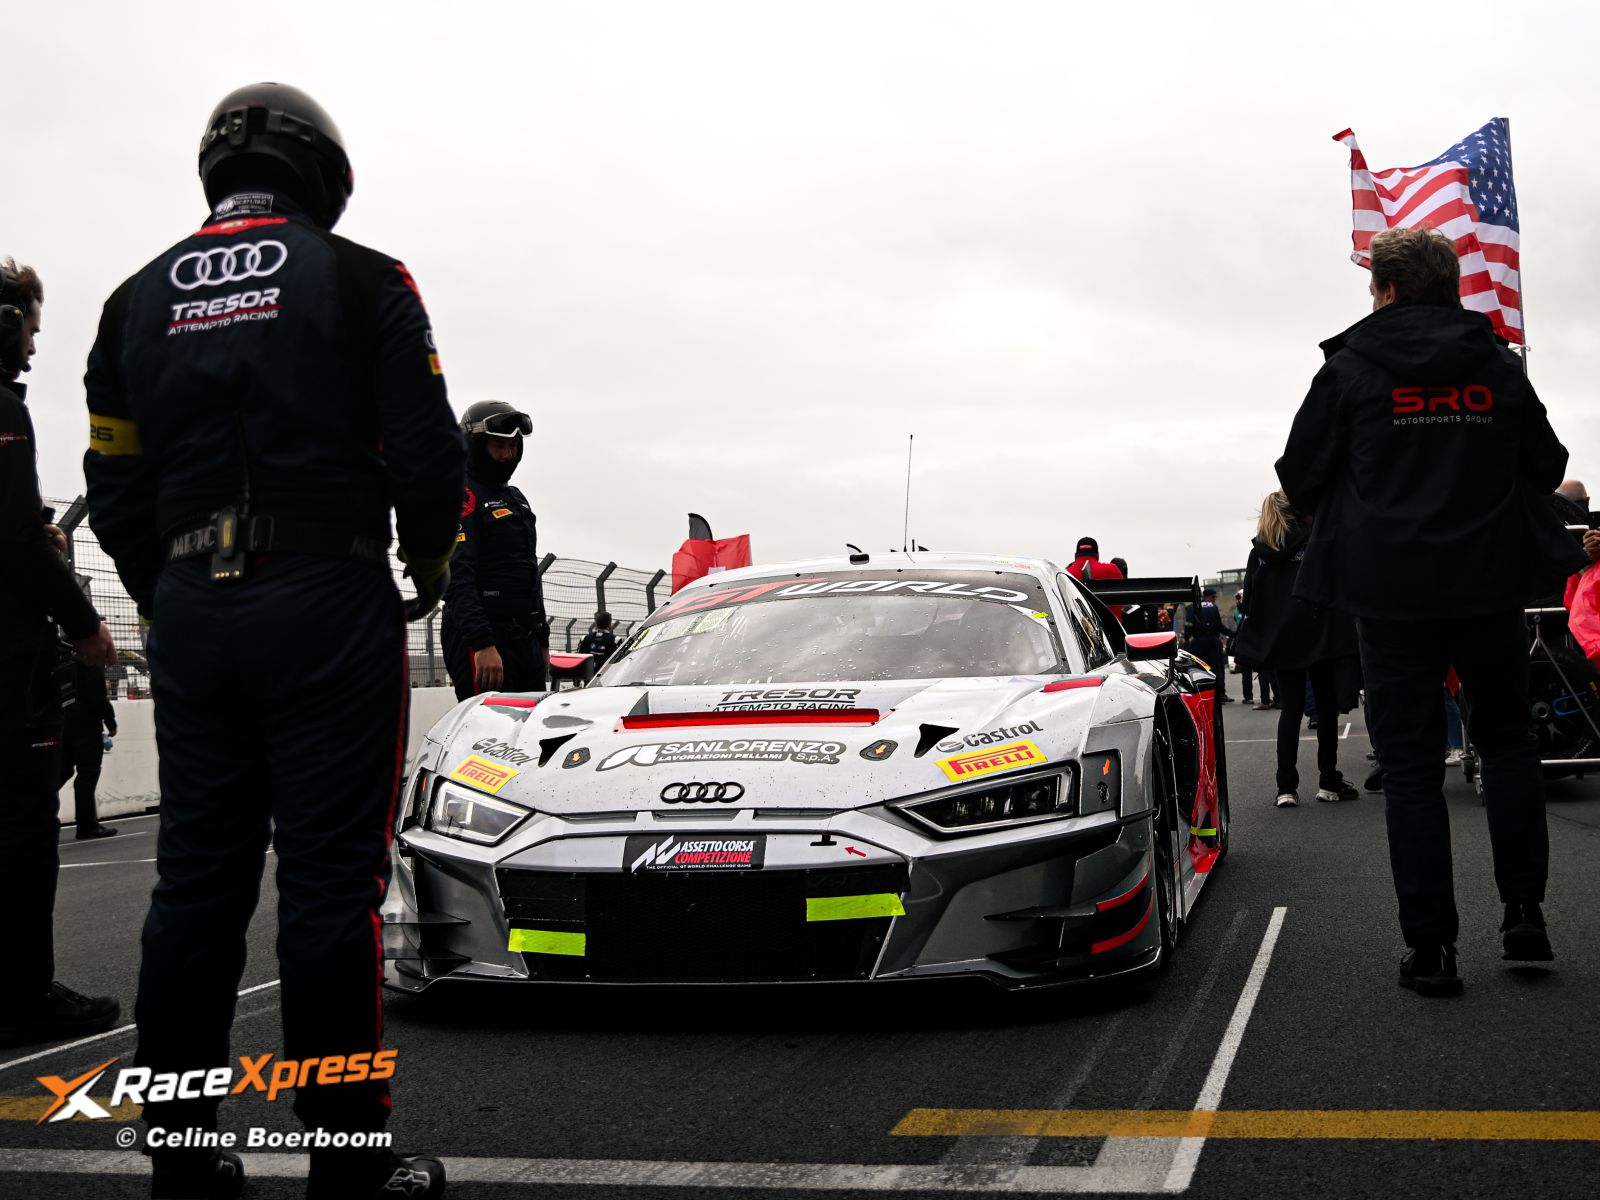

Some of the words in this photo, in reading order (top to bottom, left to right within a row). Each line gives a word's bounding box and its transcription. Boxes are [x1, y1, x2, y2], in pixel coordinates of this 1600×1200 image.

[172, 288, 281, 322] TRESOR
[167, 318, 231, 336] ATTEMPTO
[233, 310, 280, 324] RACING
[1392, 384, 1493, 414] SRO
[1393, 415, 1462, 426] MOTORSPORTS
[1465, 414, 1494, 424] GROUP
[774, 580, 1029, 602] WORLD
[721, 688, 862, 702] TRESOR
[712, 703, 792, 713] ATTEMPTO
[796, 703, 856, 711] RACING
[963, 719, 1044, 747] Castrol
[482, 742, 539, 767] Castrol
[658, 753, 733, 762] LAVORAZIONI
[796, 752, 834, 763] S.p.A.
[661, 741, 842, 755] SANLORENZO
[948, 745, 1036, 775] PIRELLI
[457, 760, 509, 787] PIRELLI
[674, 851, 752, 864] COMPETIZIONE
[680, 841, 722, 853] ASSETTO
[722, 840, 755, 852] CORSA
